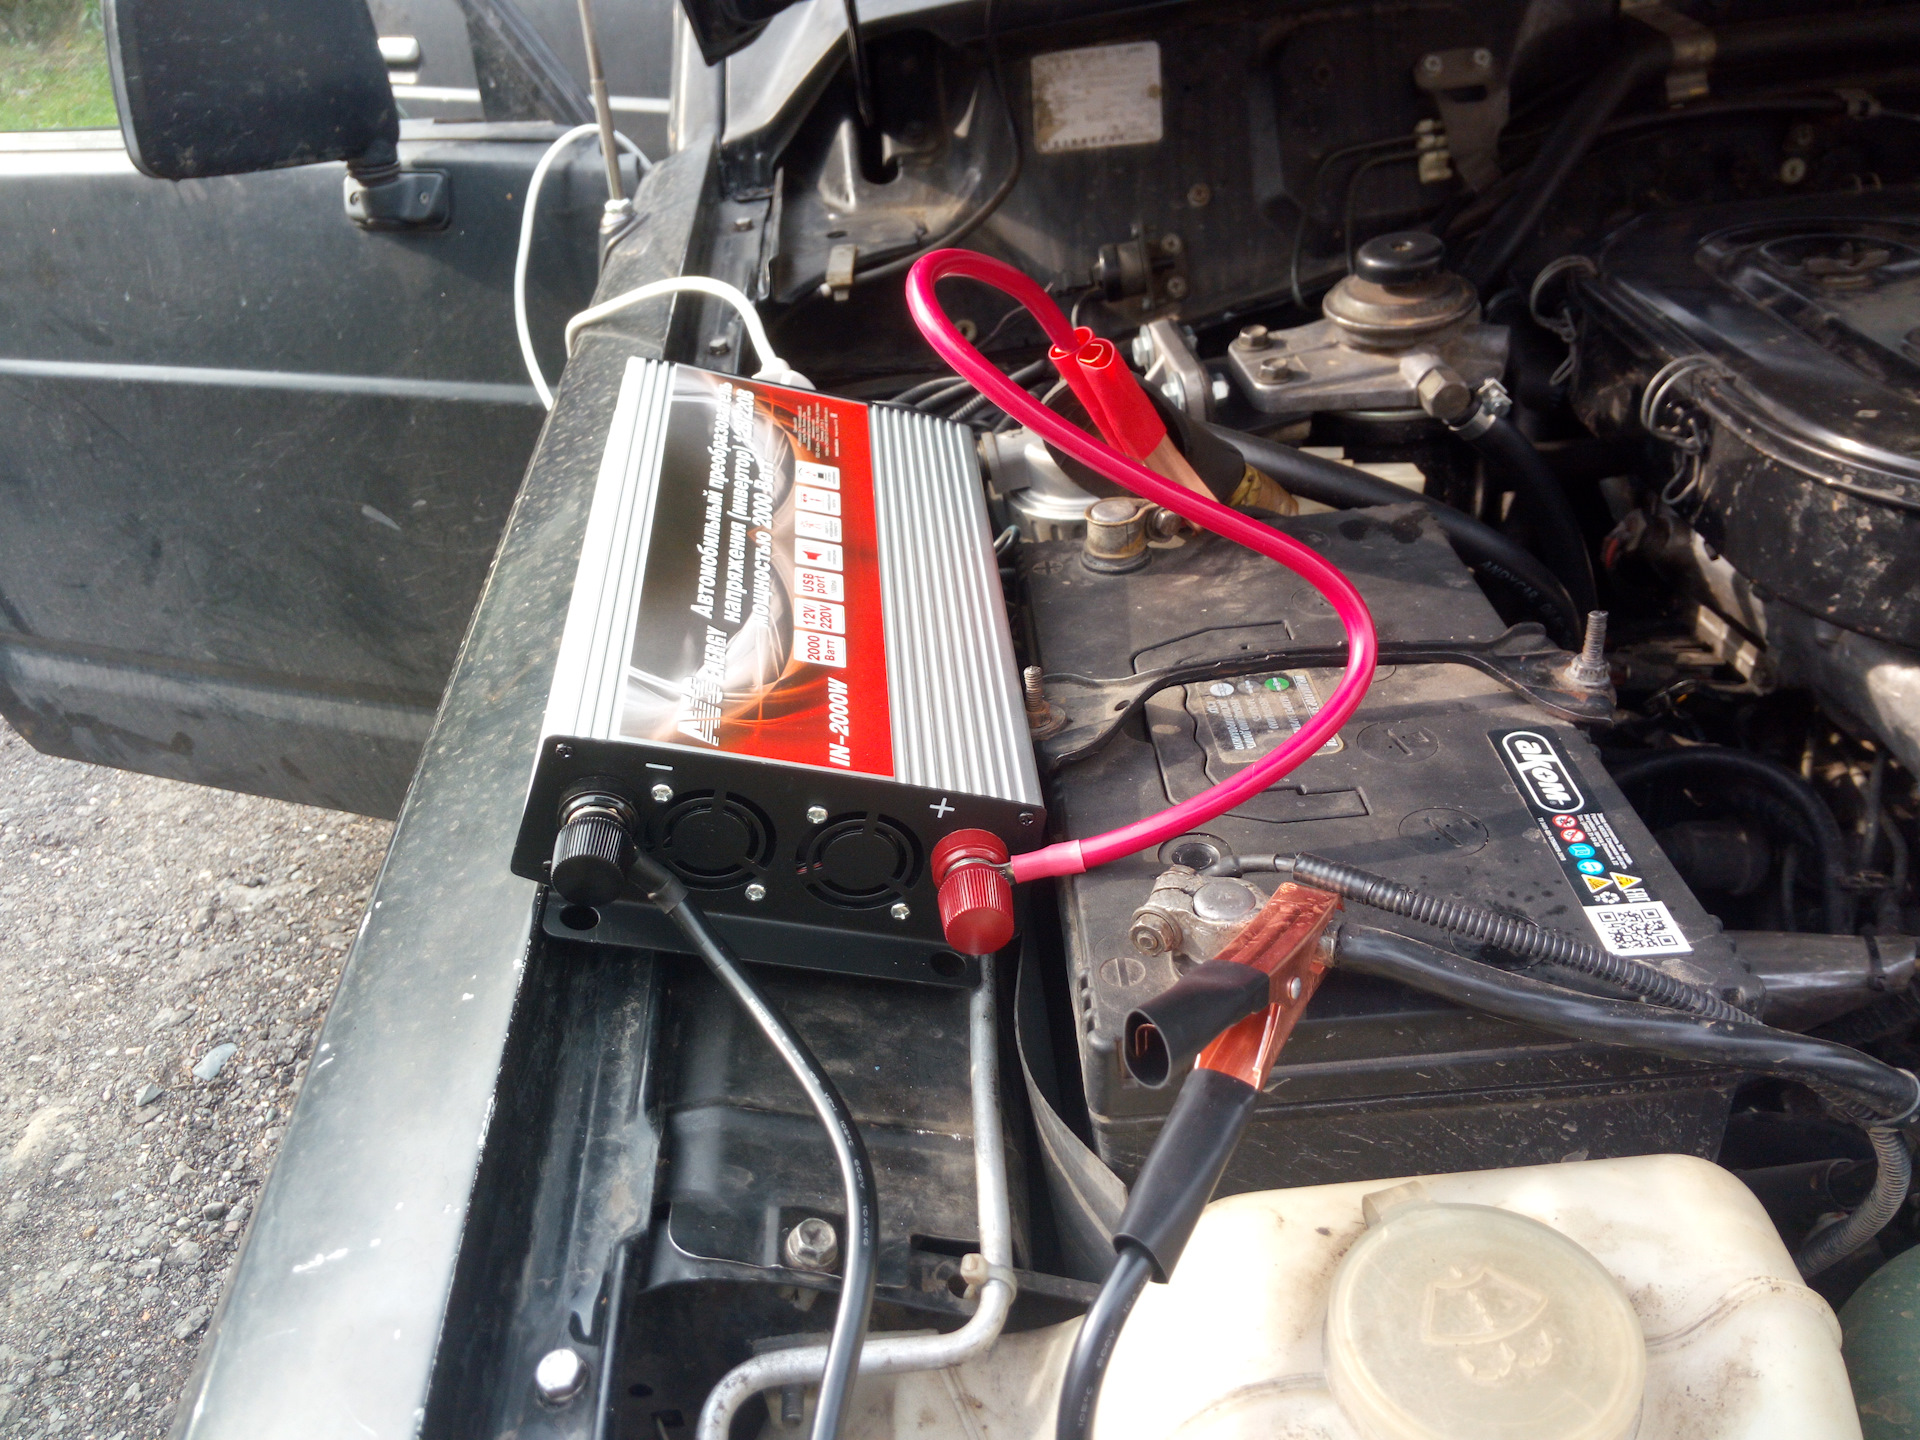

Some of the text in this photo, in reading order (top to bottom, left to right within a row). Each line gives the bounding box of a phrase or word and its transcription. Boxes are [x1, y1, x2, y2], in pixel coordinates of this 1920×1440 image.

[691, 382, 733, 620] Автомобильный преобразователь
[727, 445, 754, 521] (инвертор)
[752, 462, 774, 627] мощностью 2000 Ватт
[724, 521, 748, 623] напряжения
[803, 573, 814, 592] USB
[816, 575, 828, 594] port
[803, 603, 816, 625] 12V/
[820, 604, 832, 629] 220V
[808, 635, 820, 661] 2000
[825, 639, 835, 661] Ватт
[678, 625, 727, 746] AVS ENERGY
[828, 677, 850, 767] IN-2000W
[840, 1120, 854, 1146] 105°C
[854, 1159, 865, 1189] 600V
[1096, 1330, 1115, 1367] 600V
